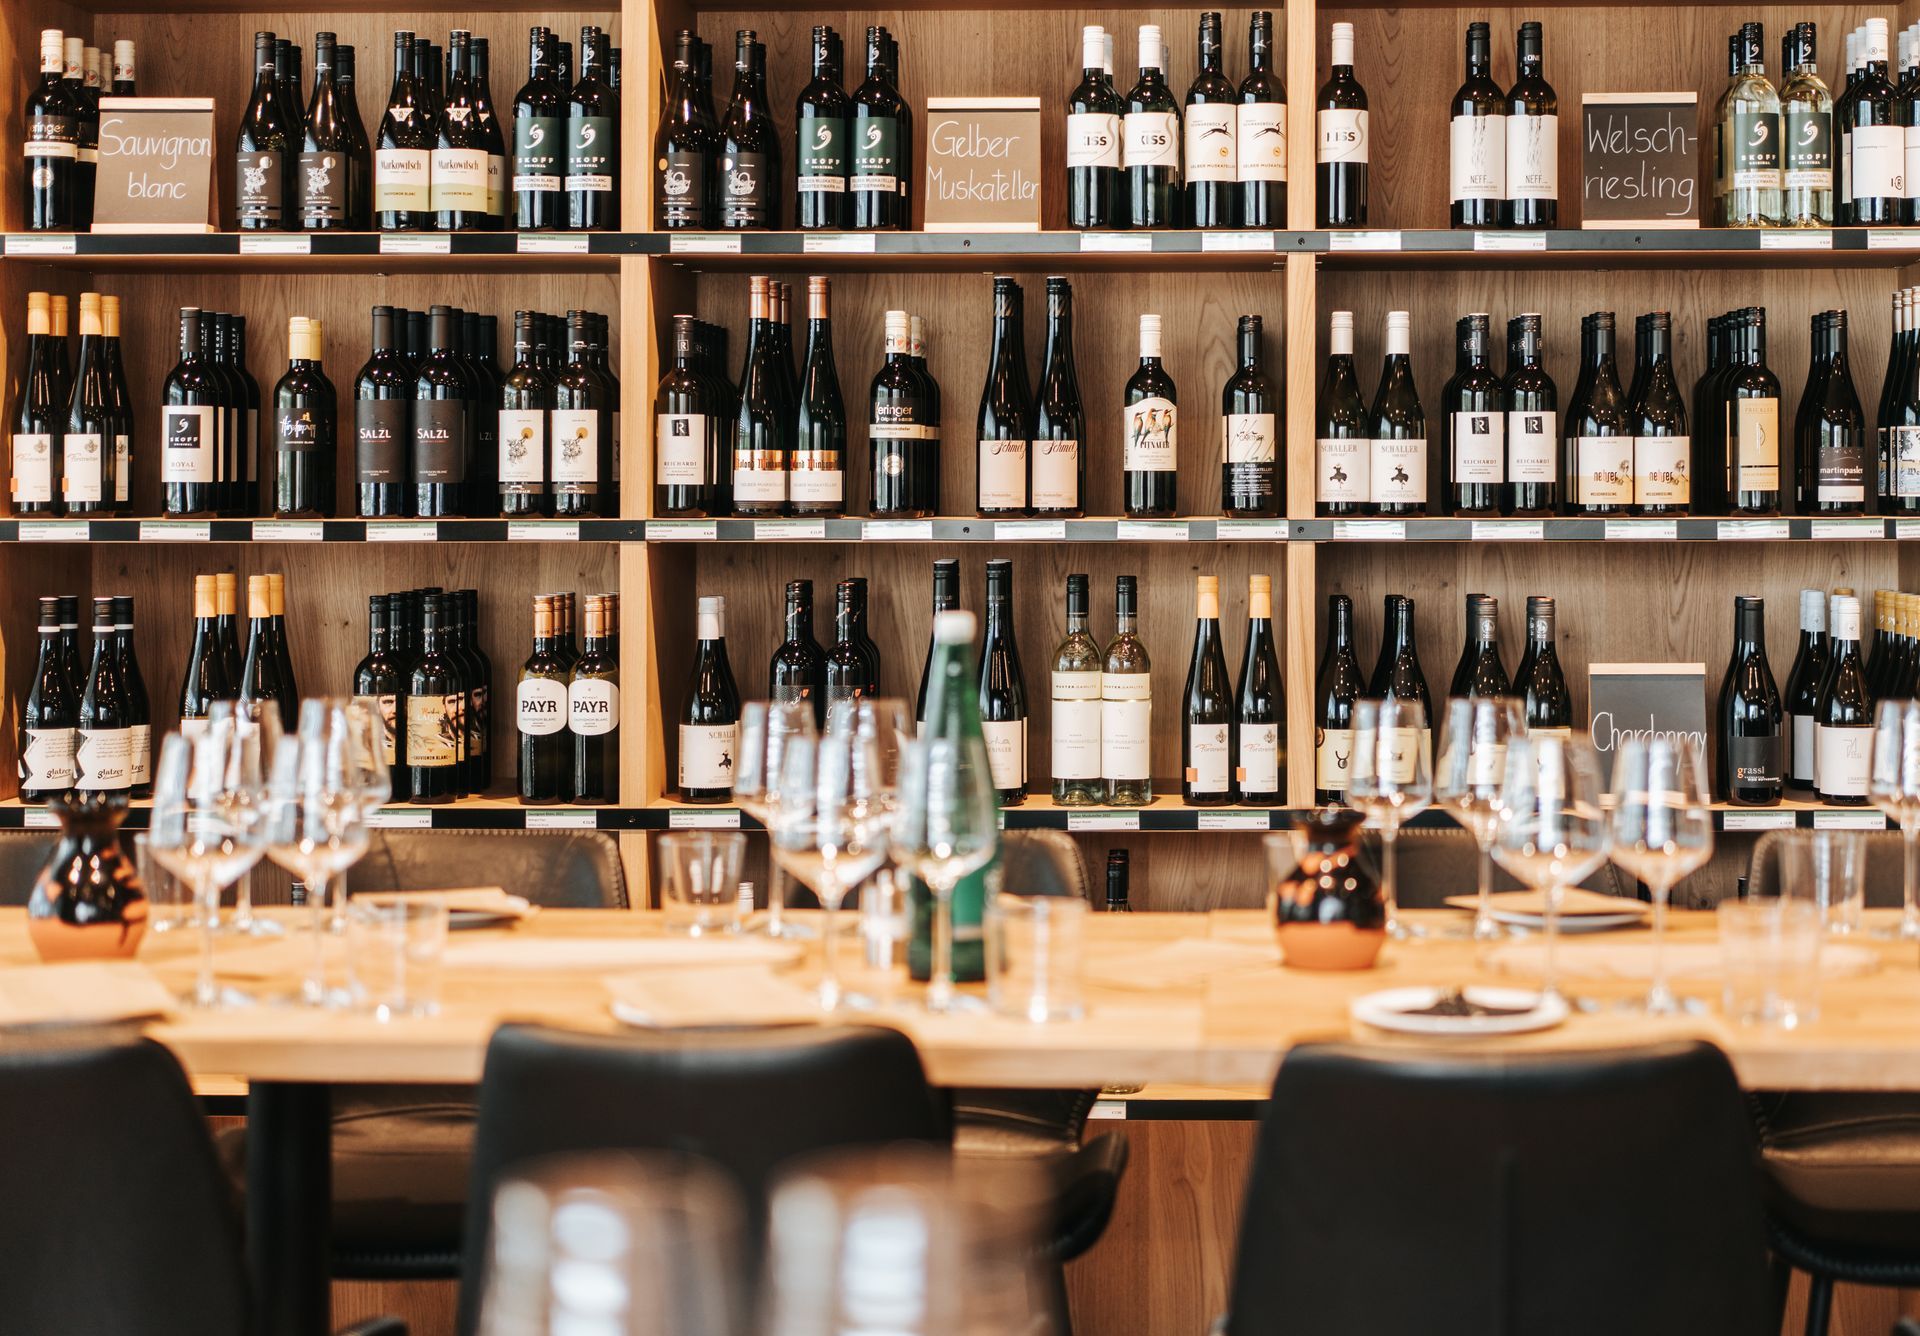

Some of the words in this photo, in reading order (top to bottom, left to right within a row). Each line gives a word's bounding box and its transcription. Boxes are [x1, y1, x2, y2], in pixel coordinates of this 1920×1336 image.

[1588, 112, 1698, 154] Welsch-
[100, 119, 212, 170] Sauvignon
[932, 120, 1021, 158] Gelber
[1084, 136, 1107, 146] ISS
[381, 160, 421, 170] Markowitsch
[438, 160, 479, 170] Markowitsch
[927, 165, 1039, 202] Muskateller
[1470, 175, 1487, 183] NEFF
[1526, 175, 1542, 183] NEFF
[128, 172, 186, 199] blanc
[1585, 160, 1694, 216] riesling
[360, 428, 391, 439] SALZL
[417, 428, 449, 439] SALZL
[1381, 445, 1418, 453] SCHALLER
[522, 700, 557, 712] PAYR
[574, 701, 608, 712] PAYR
[1592, 712, 1708, 766] Chardonnay
[47, 768, 71, 779] glatzer
[98, 768, 124, 779] glatzer
[1737, 766, 1765, 778] grassl
